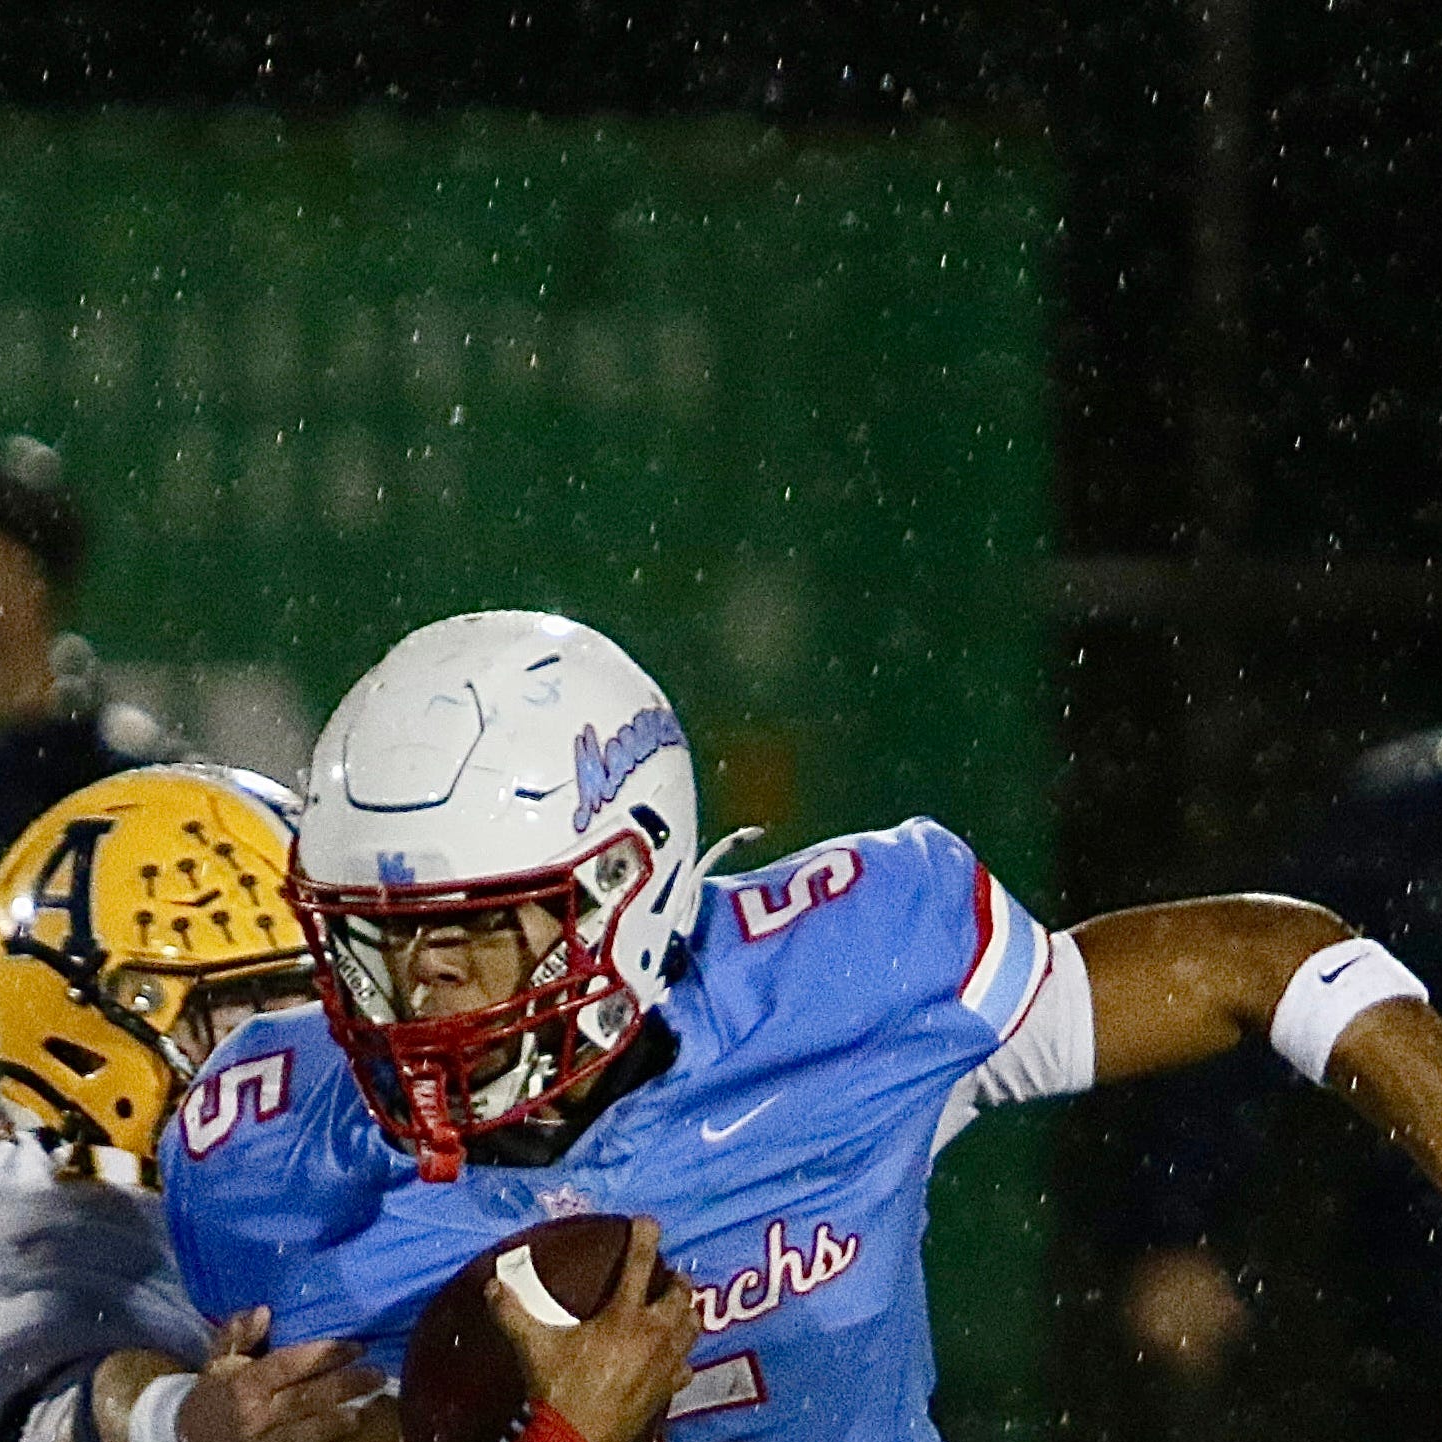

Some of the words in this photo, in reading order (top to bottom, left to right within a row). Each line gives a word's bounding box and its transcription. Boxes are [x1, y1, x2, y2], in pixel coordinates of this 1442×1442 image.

[2, 815, 119, 972] A
[729, 847, 864, 943] 5
[179, 1049, 295, 1162] 5
